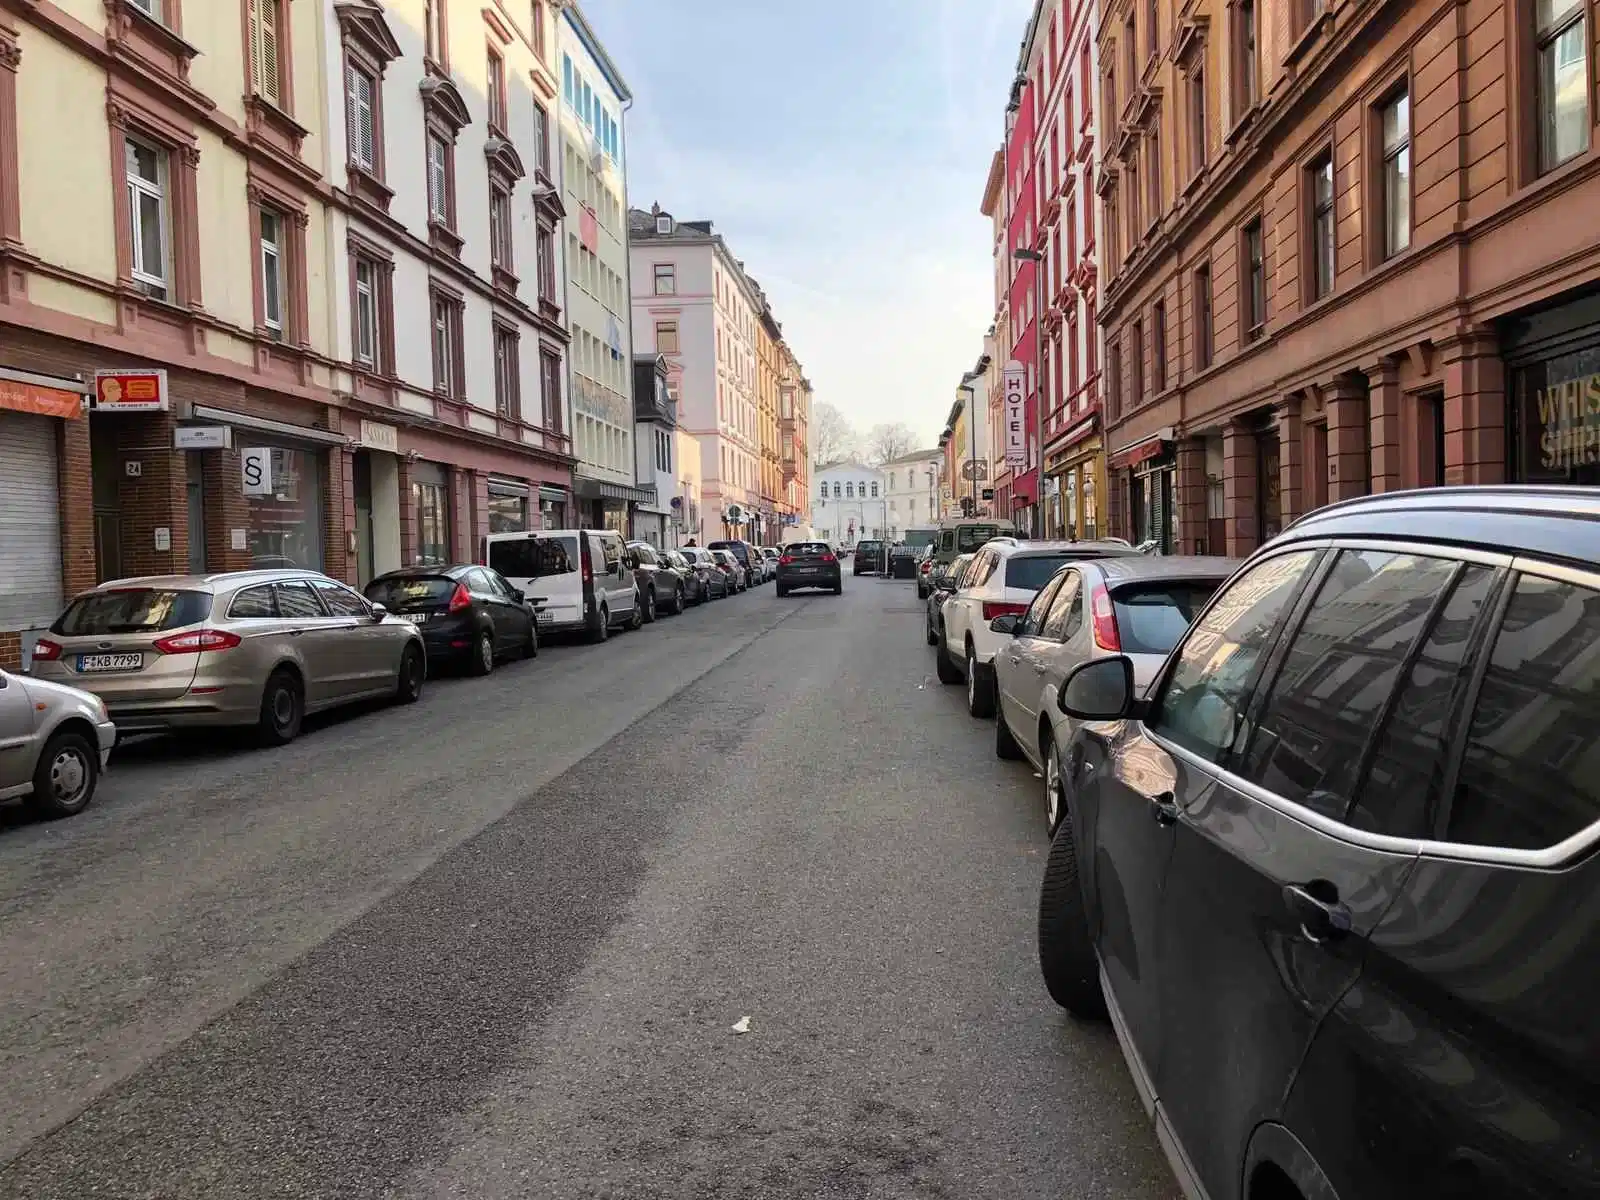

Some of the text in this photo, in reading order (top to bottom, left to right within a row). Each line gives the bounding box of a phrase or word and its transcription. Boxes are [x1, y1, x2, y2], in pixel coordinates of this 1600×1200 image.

[1007, 379, 1022, 446] HOTEL
[128, 463, 139, 474] 24
[97, 655, 111, 667] KB
[113, 654, 140, 666] 7799
